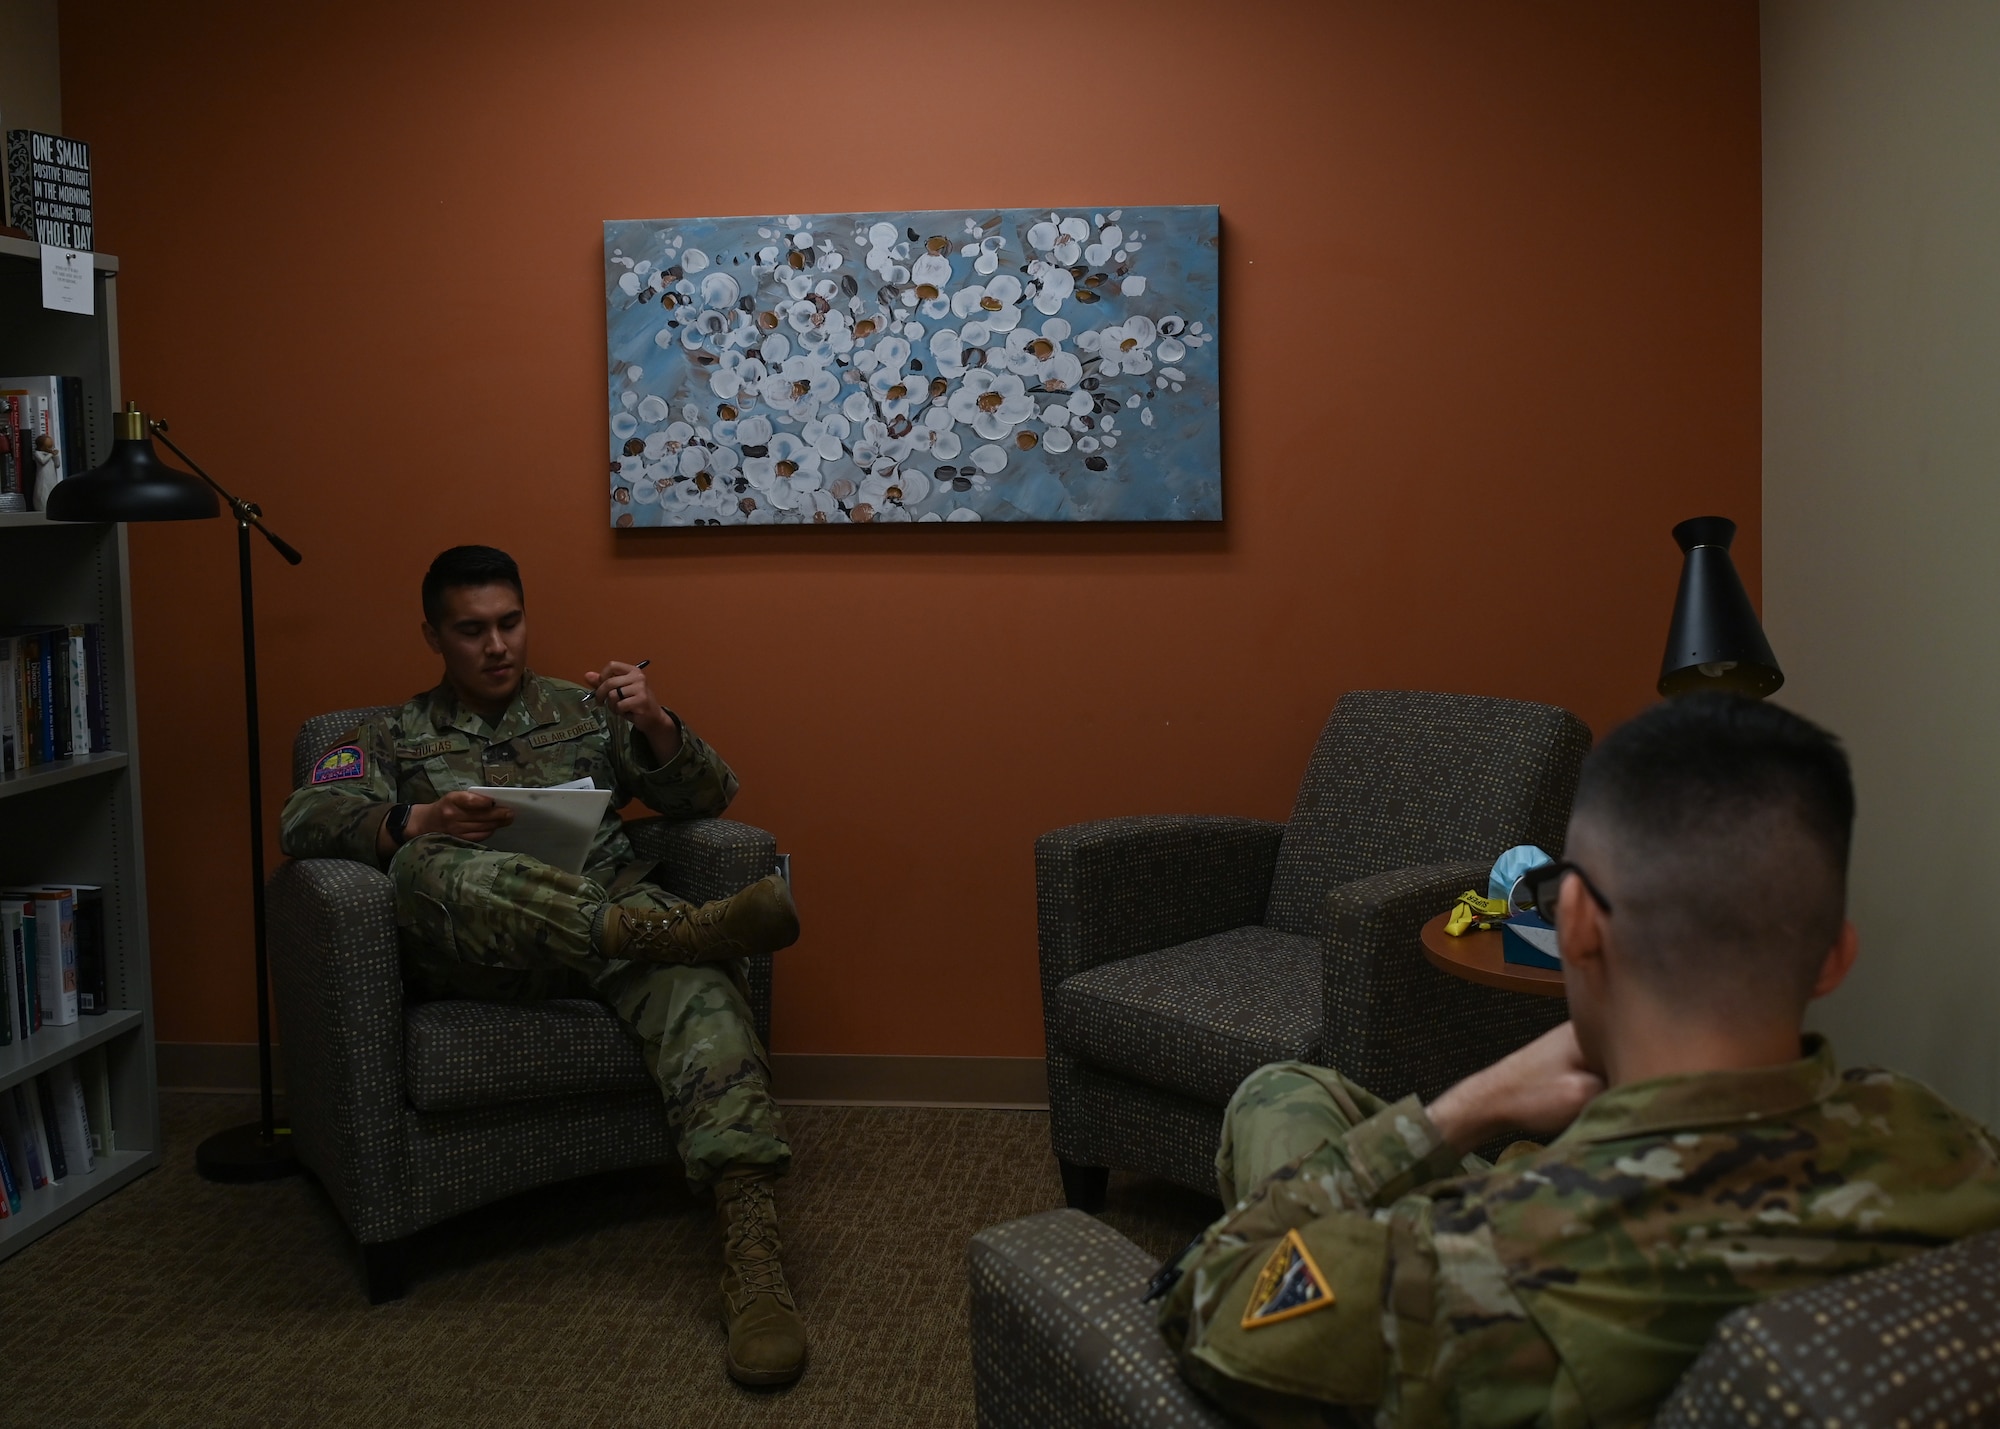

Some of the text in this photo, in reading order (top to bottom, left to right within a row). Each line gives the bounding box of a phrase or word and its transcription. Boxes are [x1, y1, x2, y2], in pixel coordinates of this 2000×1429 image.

[32, 134, 89, 169] ONE SMALL
[33, 162, 89, 187] POSITIVE THOUGHT
[34, 180, 90, 206] IN THE MORNING
[35, 200, 91, 223] CAN CHANGE YOUR
[36, 218, 92, 251] WHOLE DAY
[532, 721, 596, 745] US AIR FORCE
